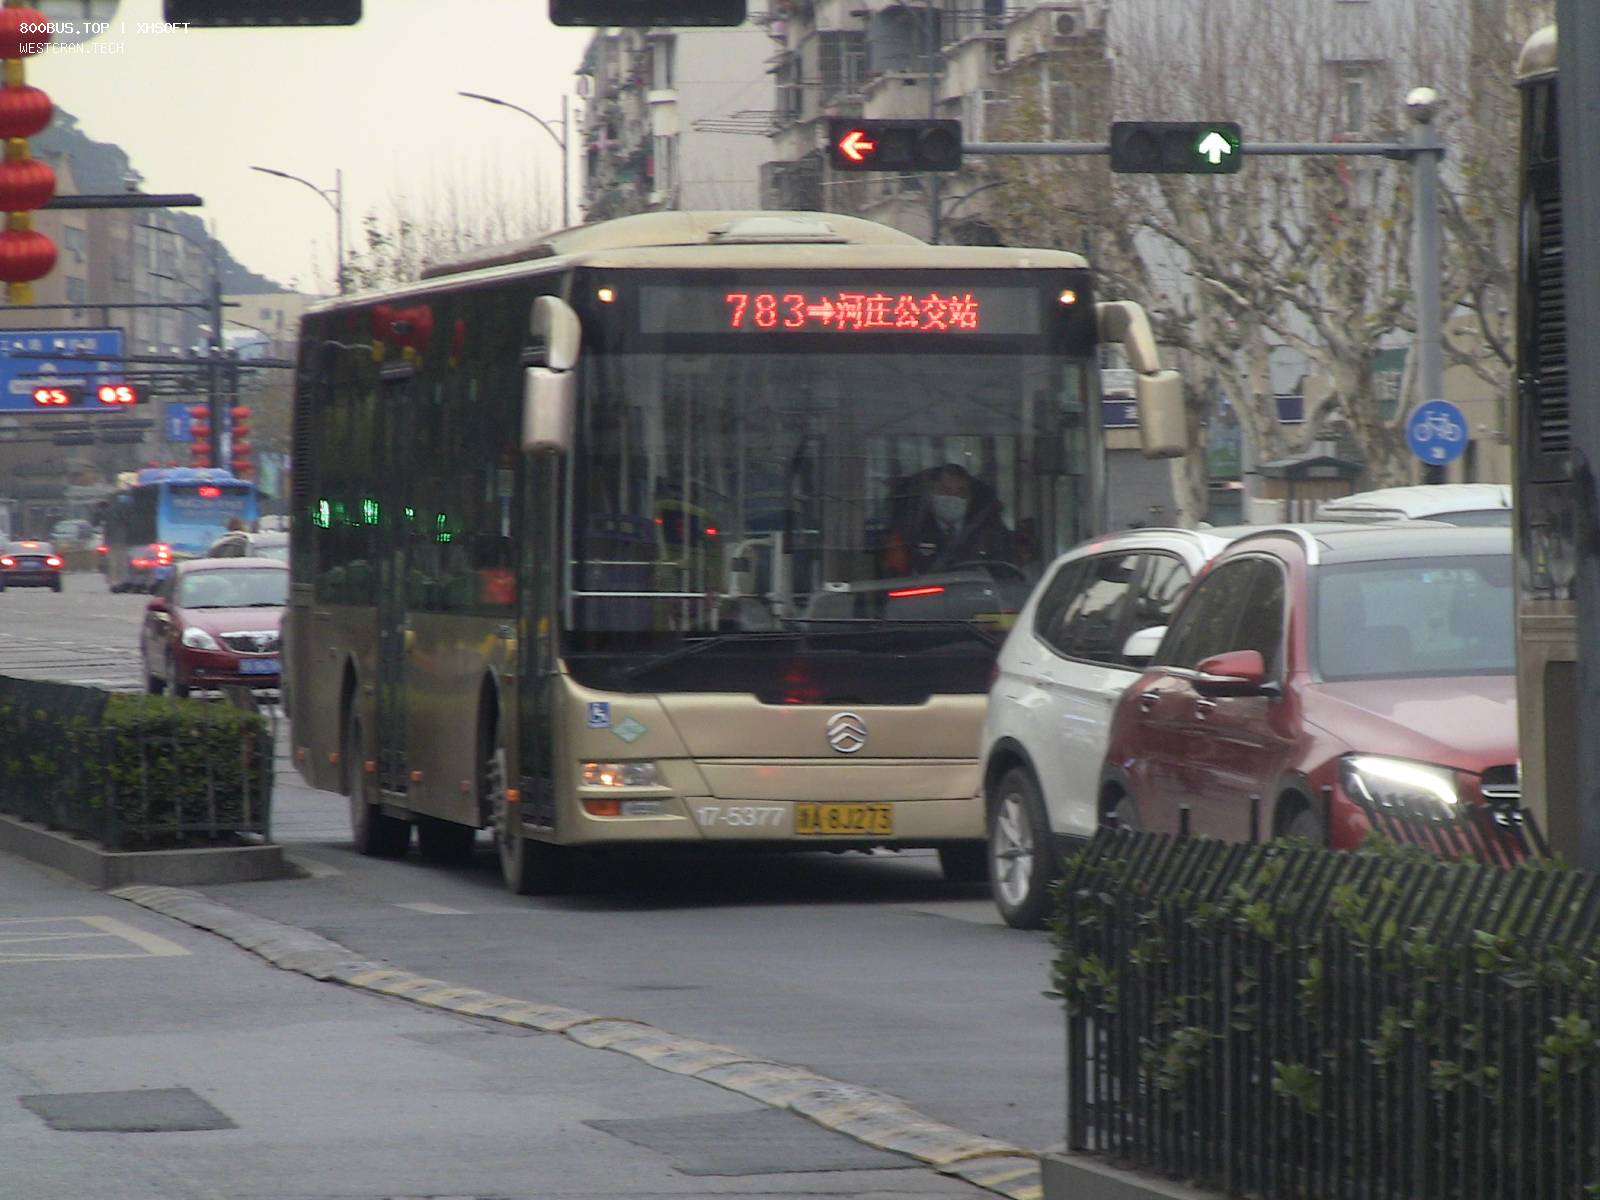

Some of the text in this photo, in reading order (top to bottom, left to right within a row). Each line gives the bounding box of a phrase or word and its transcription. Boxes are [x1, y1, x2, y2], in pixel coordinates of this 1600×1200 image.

[725, 292, 979, 331] 783 河庄公交站
[696, 806, 785, 826] 17-5377
